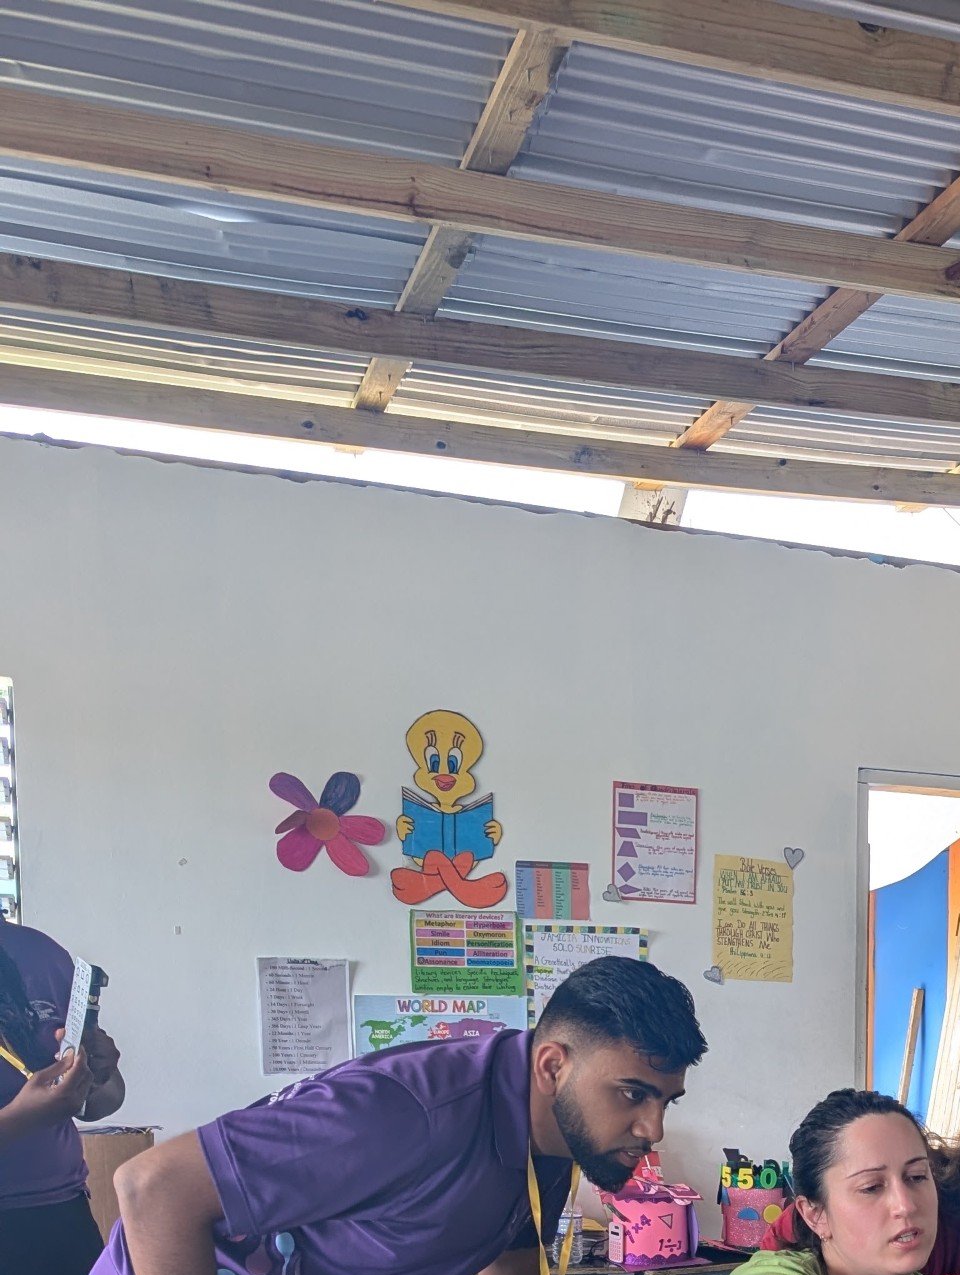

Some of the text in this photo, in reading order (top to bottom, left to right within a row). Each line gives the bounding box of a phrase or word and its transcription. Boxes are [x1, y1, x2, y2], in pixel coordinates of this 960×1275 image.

[424, 920, 456, 928] Metaphor
[473, 931, 506, 939] Oxymoron
[466, 940, 514, 948] Personification
[552, 943, 613, 956] SOLO SUNRISE
[466, 958, 514, 966] Onomatopoeia
[540, 956, 575, 970] Genetically
[397, 999, 486, 1014] WORLD MAP
